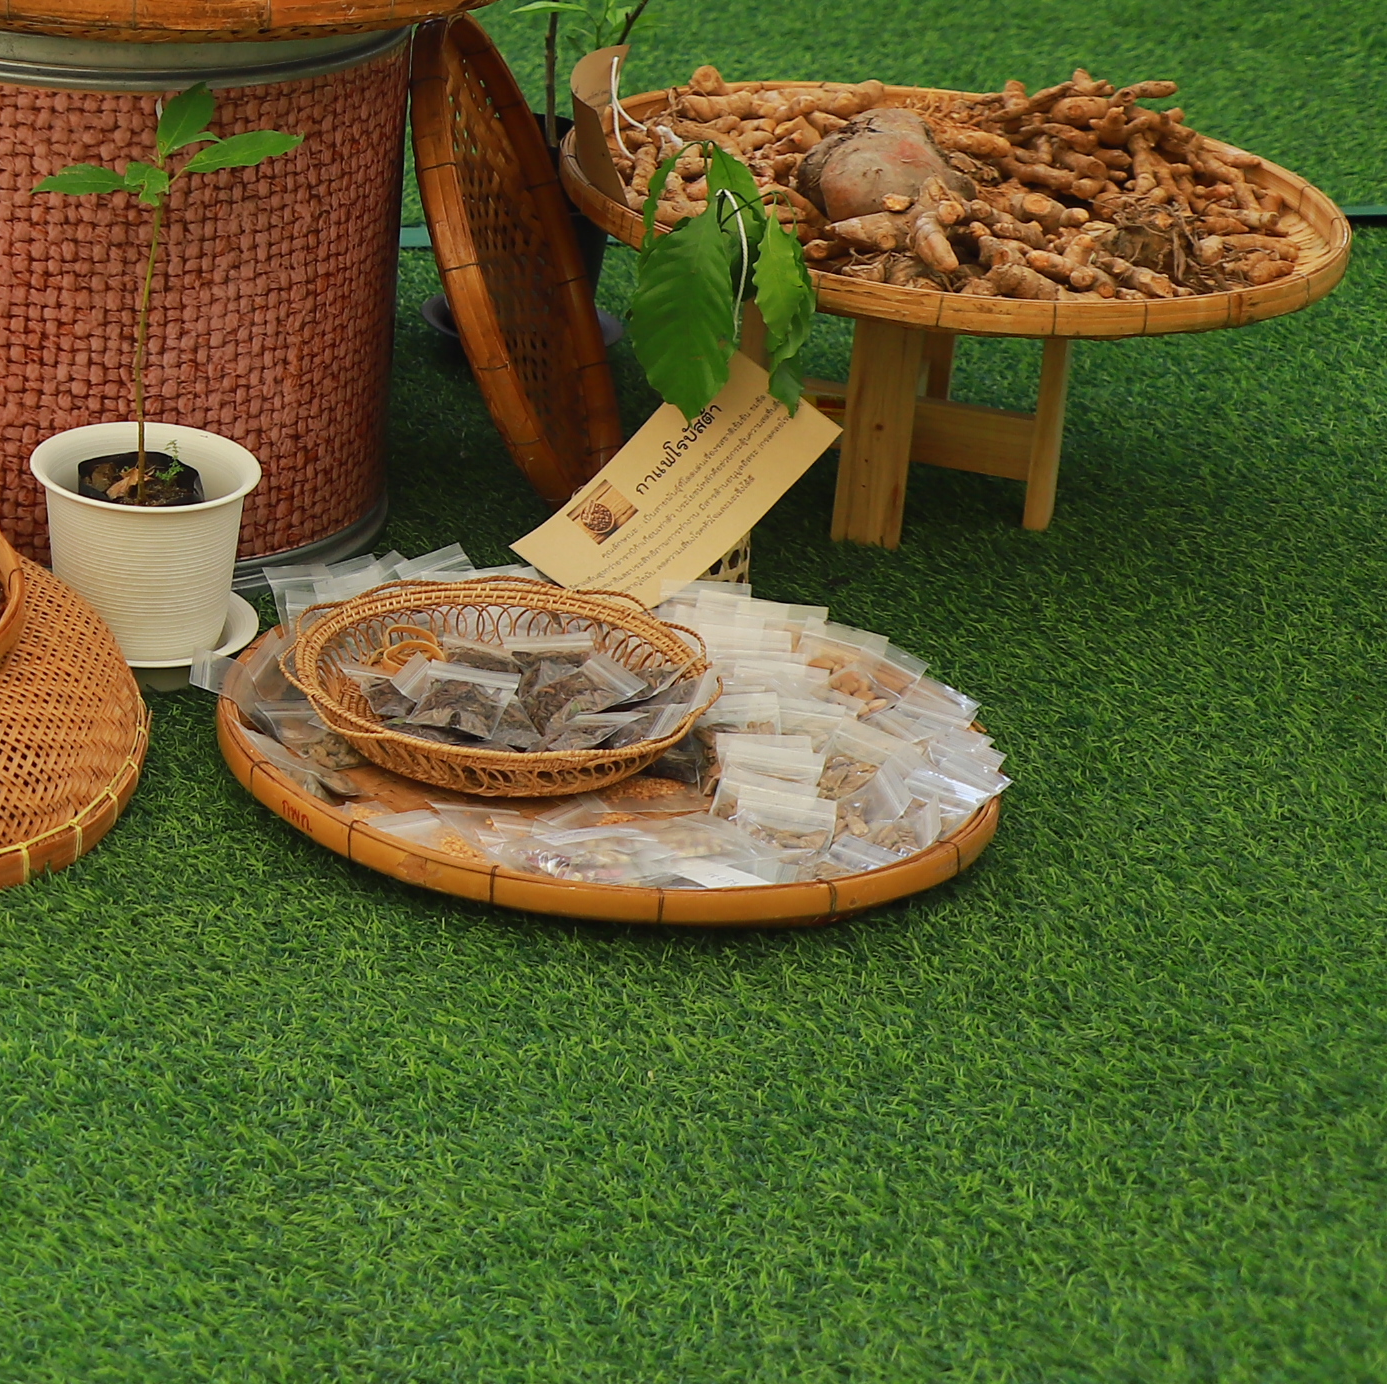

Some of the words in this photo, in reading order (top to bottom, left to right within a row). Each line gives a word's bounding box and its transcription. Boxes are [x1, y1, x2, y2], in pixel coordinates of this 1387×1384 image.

[634, 402, 724, 497] กาแฟโรบัสต้า
